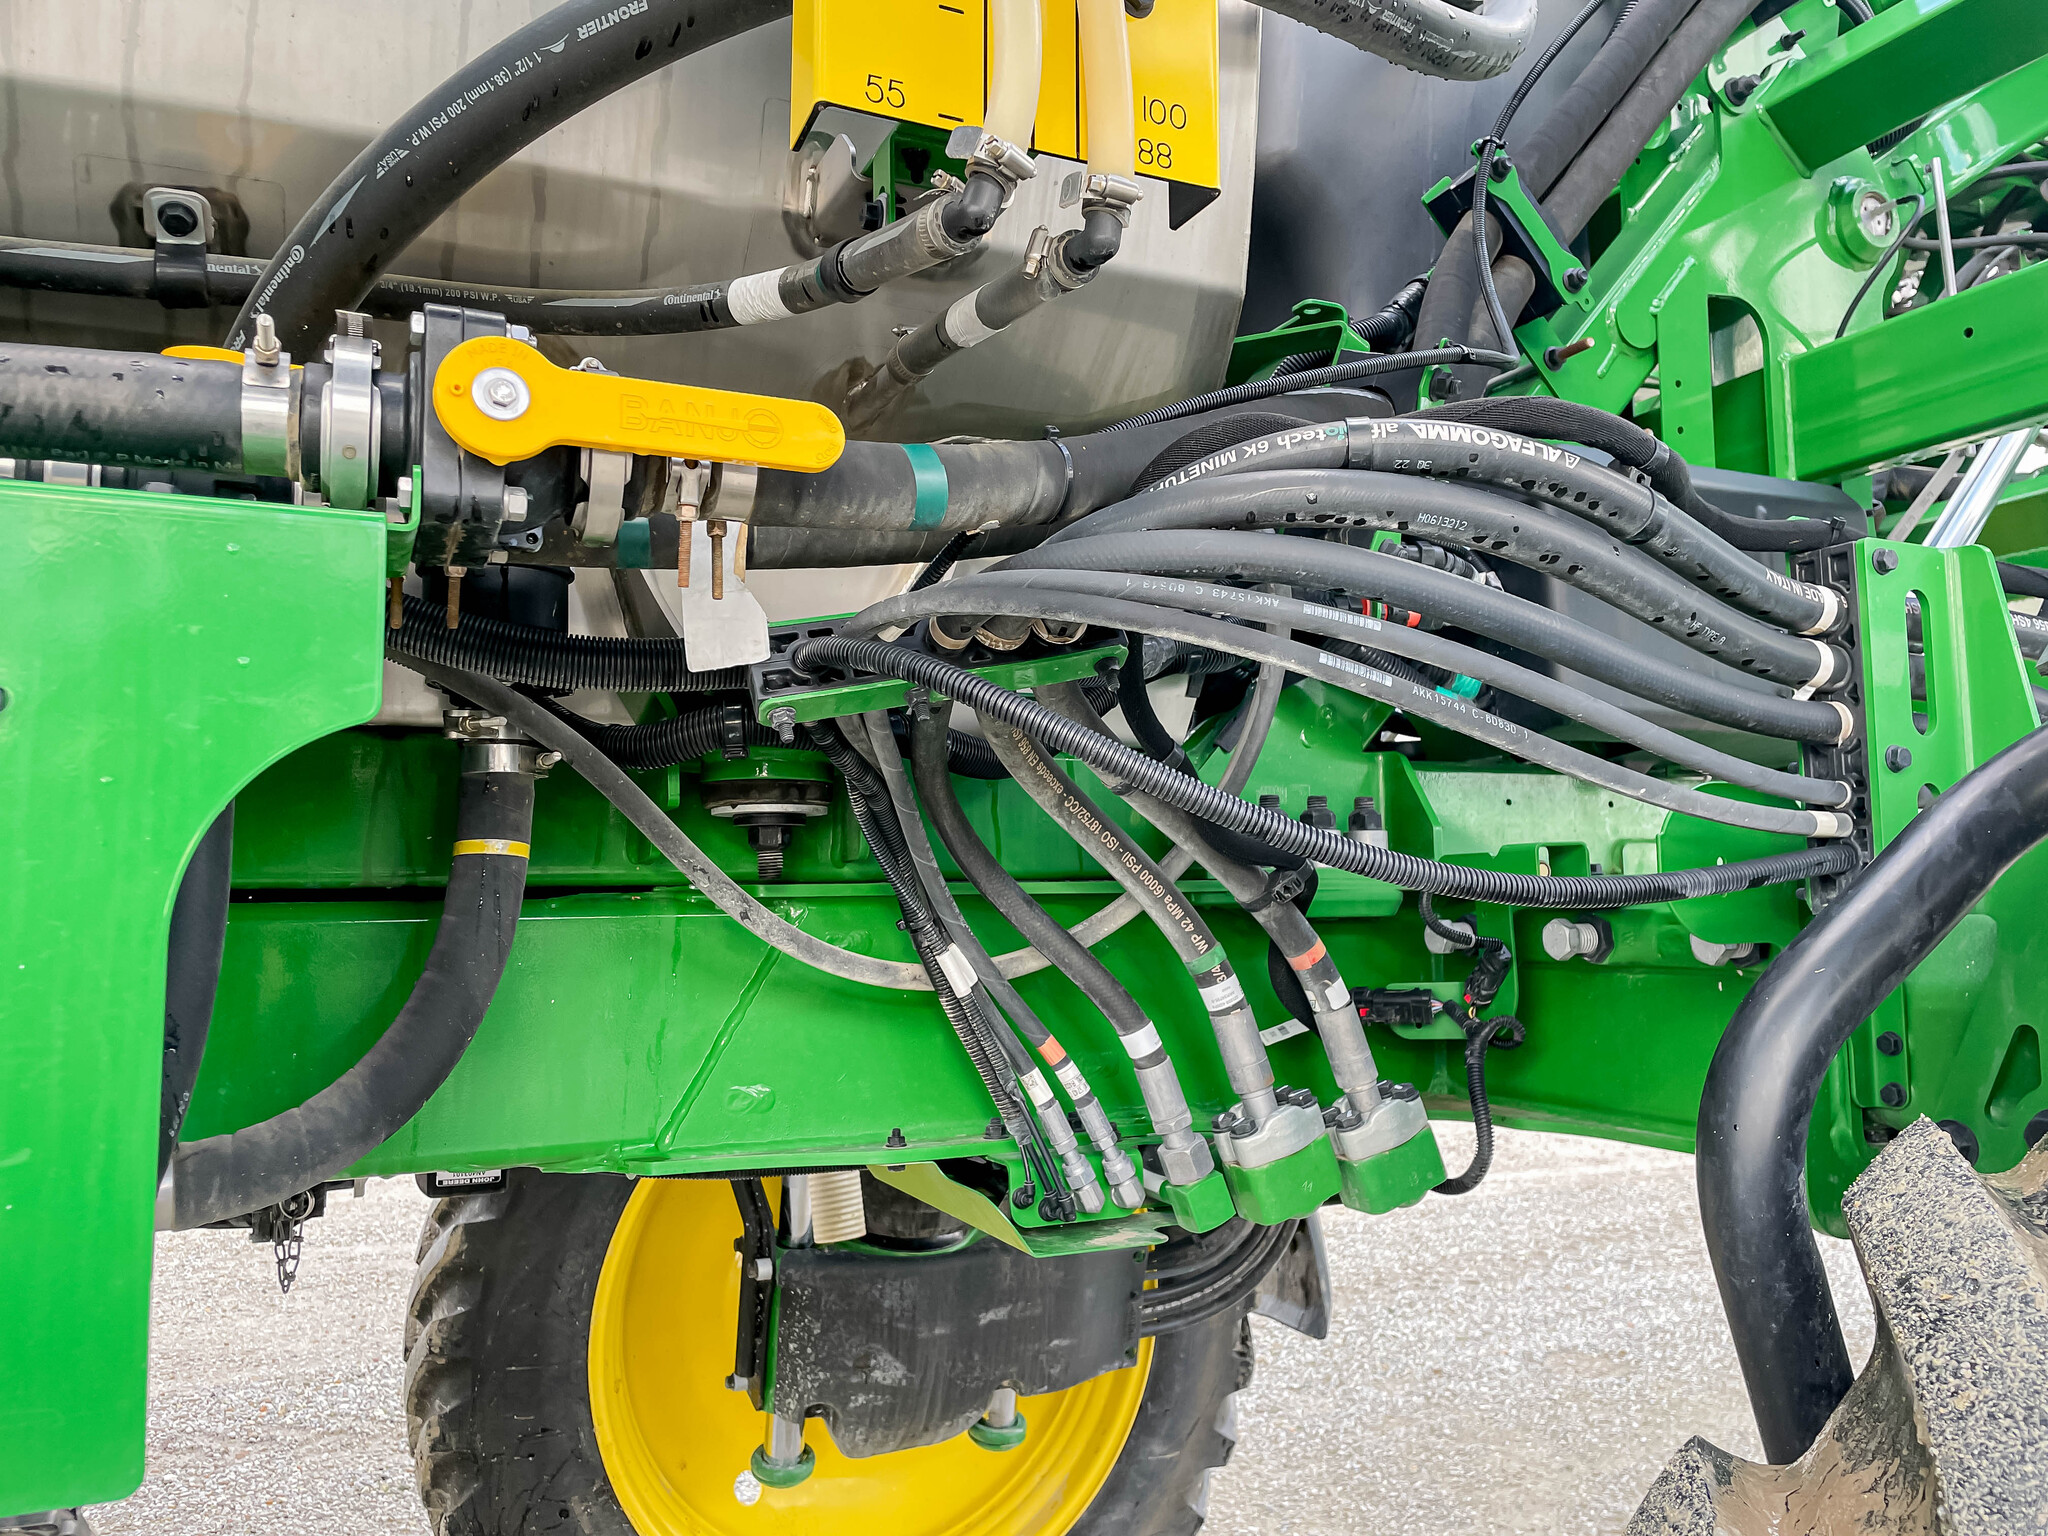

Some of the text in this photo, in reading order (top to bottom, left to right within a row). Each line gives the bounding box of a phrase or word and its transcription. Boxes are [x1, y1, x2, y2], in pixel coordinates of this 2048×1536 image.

[577, 0, 649, 42] FRONTIER
[463, 66, 513, 106] (38.1mm)
[864, 73, 906, 109] 55
[446, 98, 467, 118] 200
[1142, 95, 1187, 130] 100
[428, 112, 449, 131] PSI
[406, 125, 432, 146] W.P.
[1138, 138, 1173, 169] 88
[254, 244, 305, 313] Continental
[400, 283, 443, 297] (19.1mm)
[446, 288, 461, 298] 200
[464, 291, 479, 300] PSI
[664, 289, 715, 306] Continental
[619, 393, 784, 450] BANJO
[1243, 440, 1270, 460] 6K
[1408, 422, 1562, 464] ALFAGOMMA
[1393, 459, 1410, 469] 22
[1412, 685, 1466, 714] AKK15744
[1018, 737, 1032, 755] 856
[1025, 750, 1040, 767] EN
[1036, 761, 1064, 794] exceeds
[1064, 795, 1103, 835] 18752/CC
[1100, 831, 1120, 851] ISO
[1121, 851, 1143, 874] PSI)
[1139, 869, 1166, 899] (6000
[1163, 894, 1185, 921] MPa
[1180, 916, 1194, 932] 42
[1190, 933, 1209, 954] WP
[443, 1178, 471, 1186] DEERE
